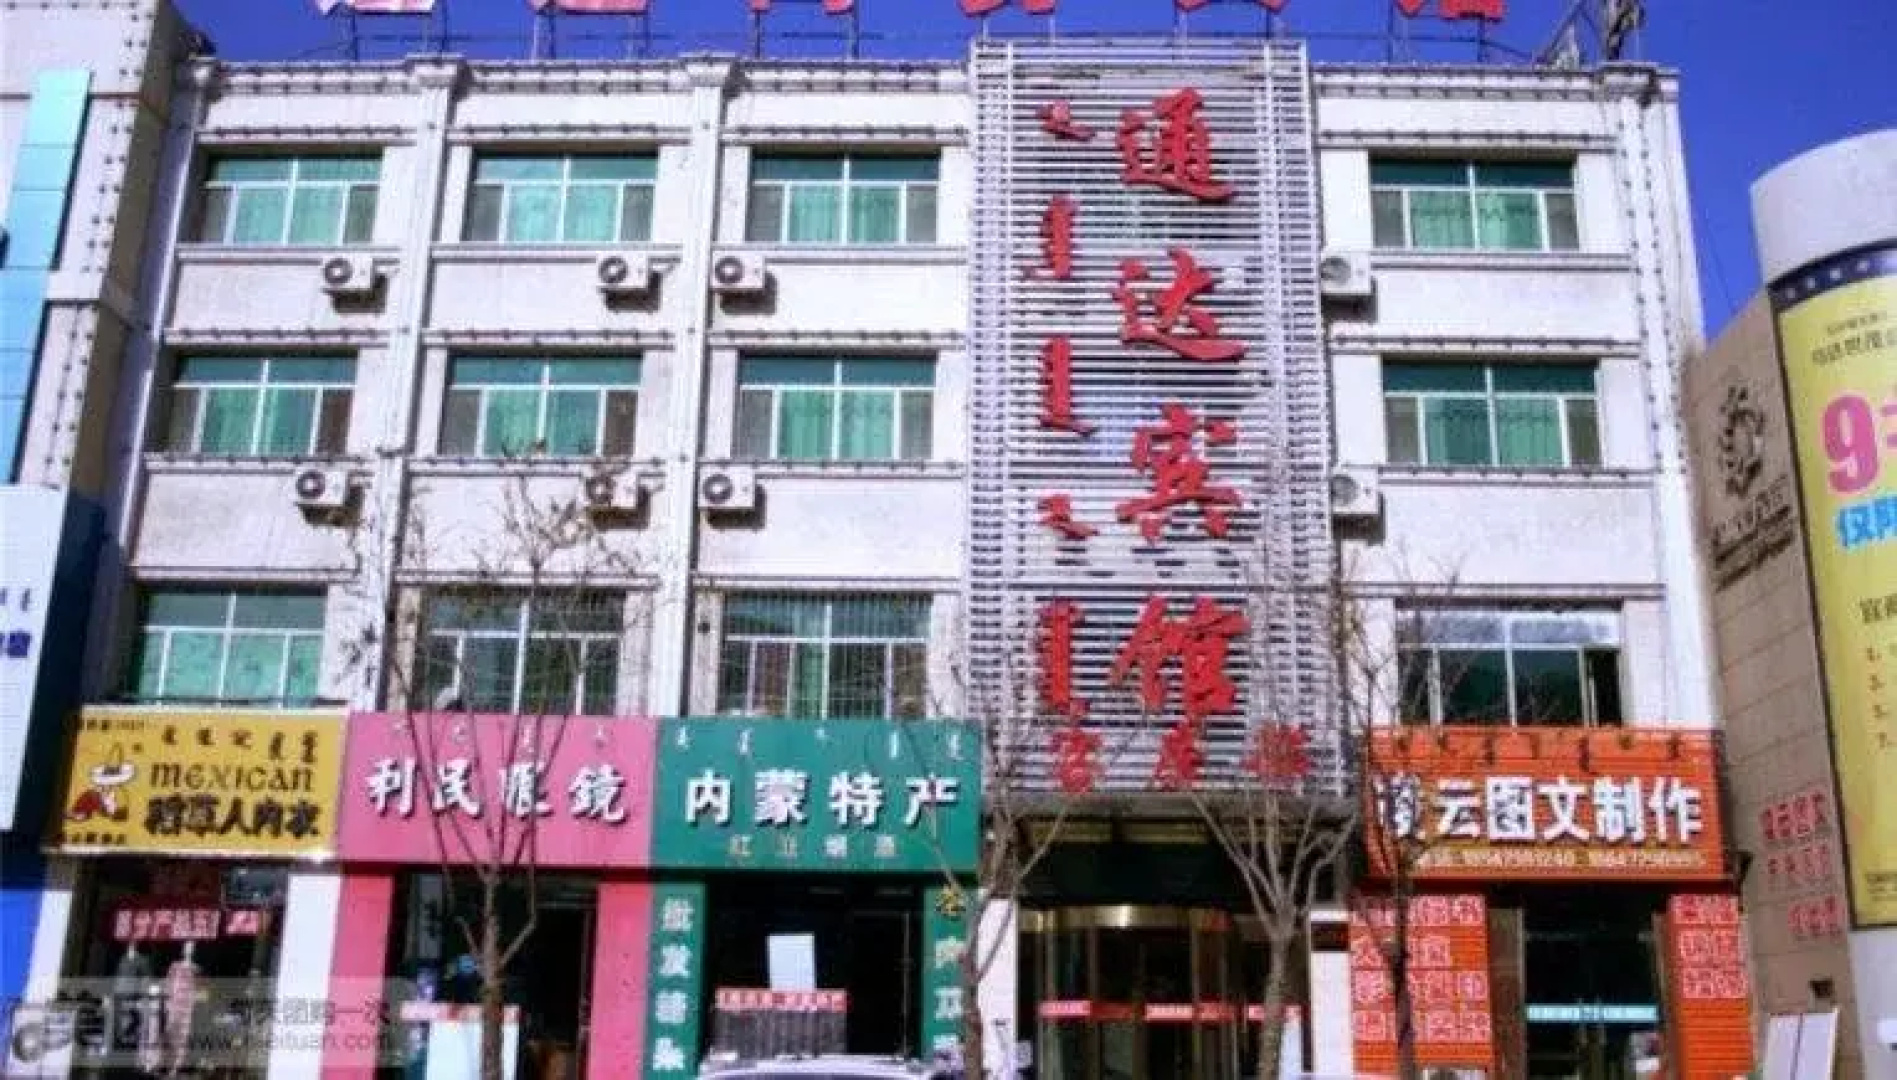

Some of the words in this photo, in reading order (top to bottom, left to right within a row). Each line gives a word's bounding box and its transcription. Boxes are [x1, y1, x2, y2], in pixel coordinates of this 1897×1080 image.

[1109, 86, 1250, 714] 通达宾馆
[684, 768, 959, 828] 内蒙特产
